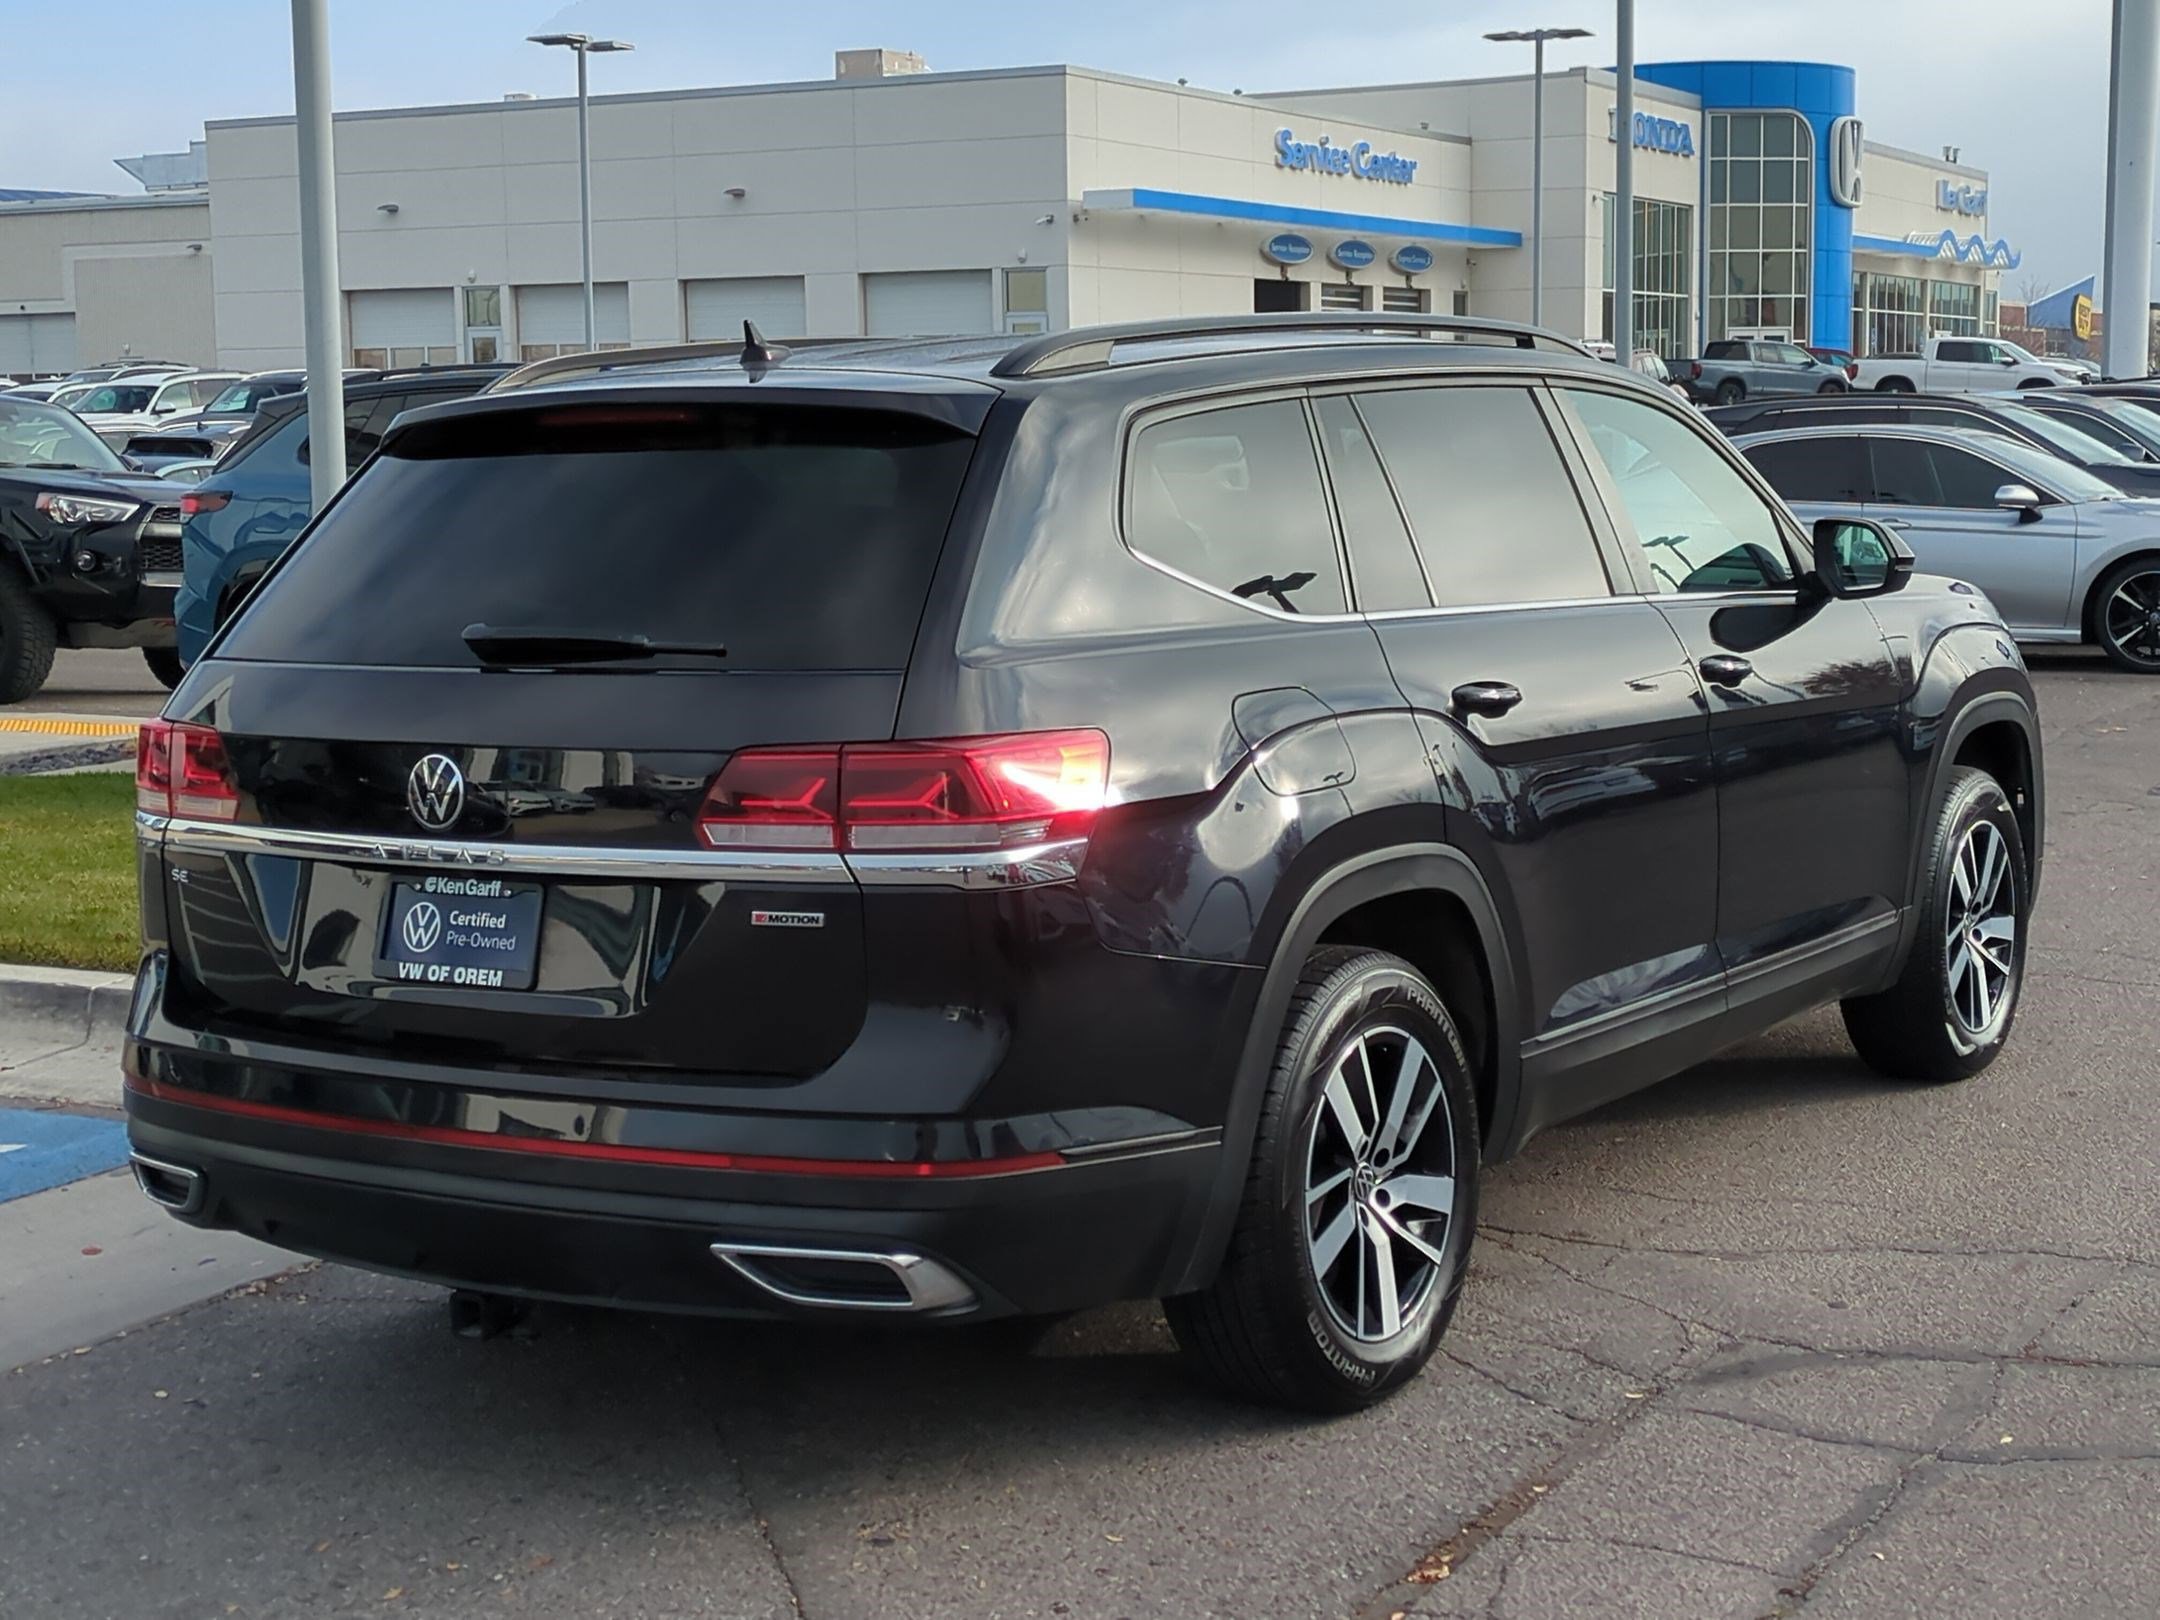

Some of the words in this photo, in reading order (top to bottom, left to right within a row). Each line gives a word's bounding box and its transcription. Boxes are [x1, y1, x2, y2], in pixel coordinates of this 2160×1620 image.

[1608, 108, 1695, 156] ONDA
[1275, 129, 1350, 175] Service
[1351, 142, 1417, 185] Center
[171, 868, 189, 883] SE
[450, 911, 506, 929] Certified
[446, 931, 516, 951] Pre-Owned
[399, 962, 424, 980] VW
[427, 965, 450, 982] OF
[453, 967, 503, 987] OREM
